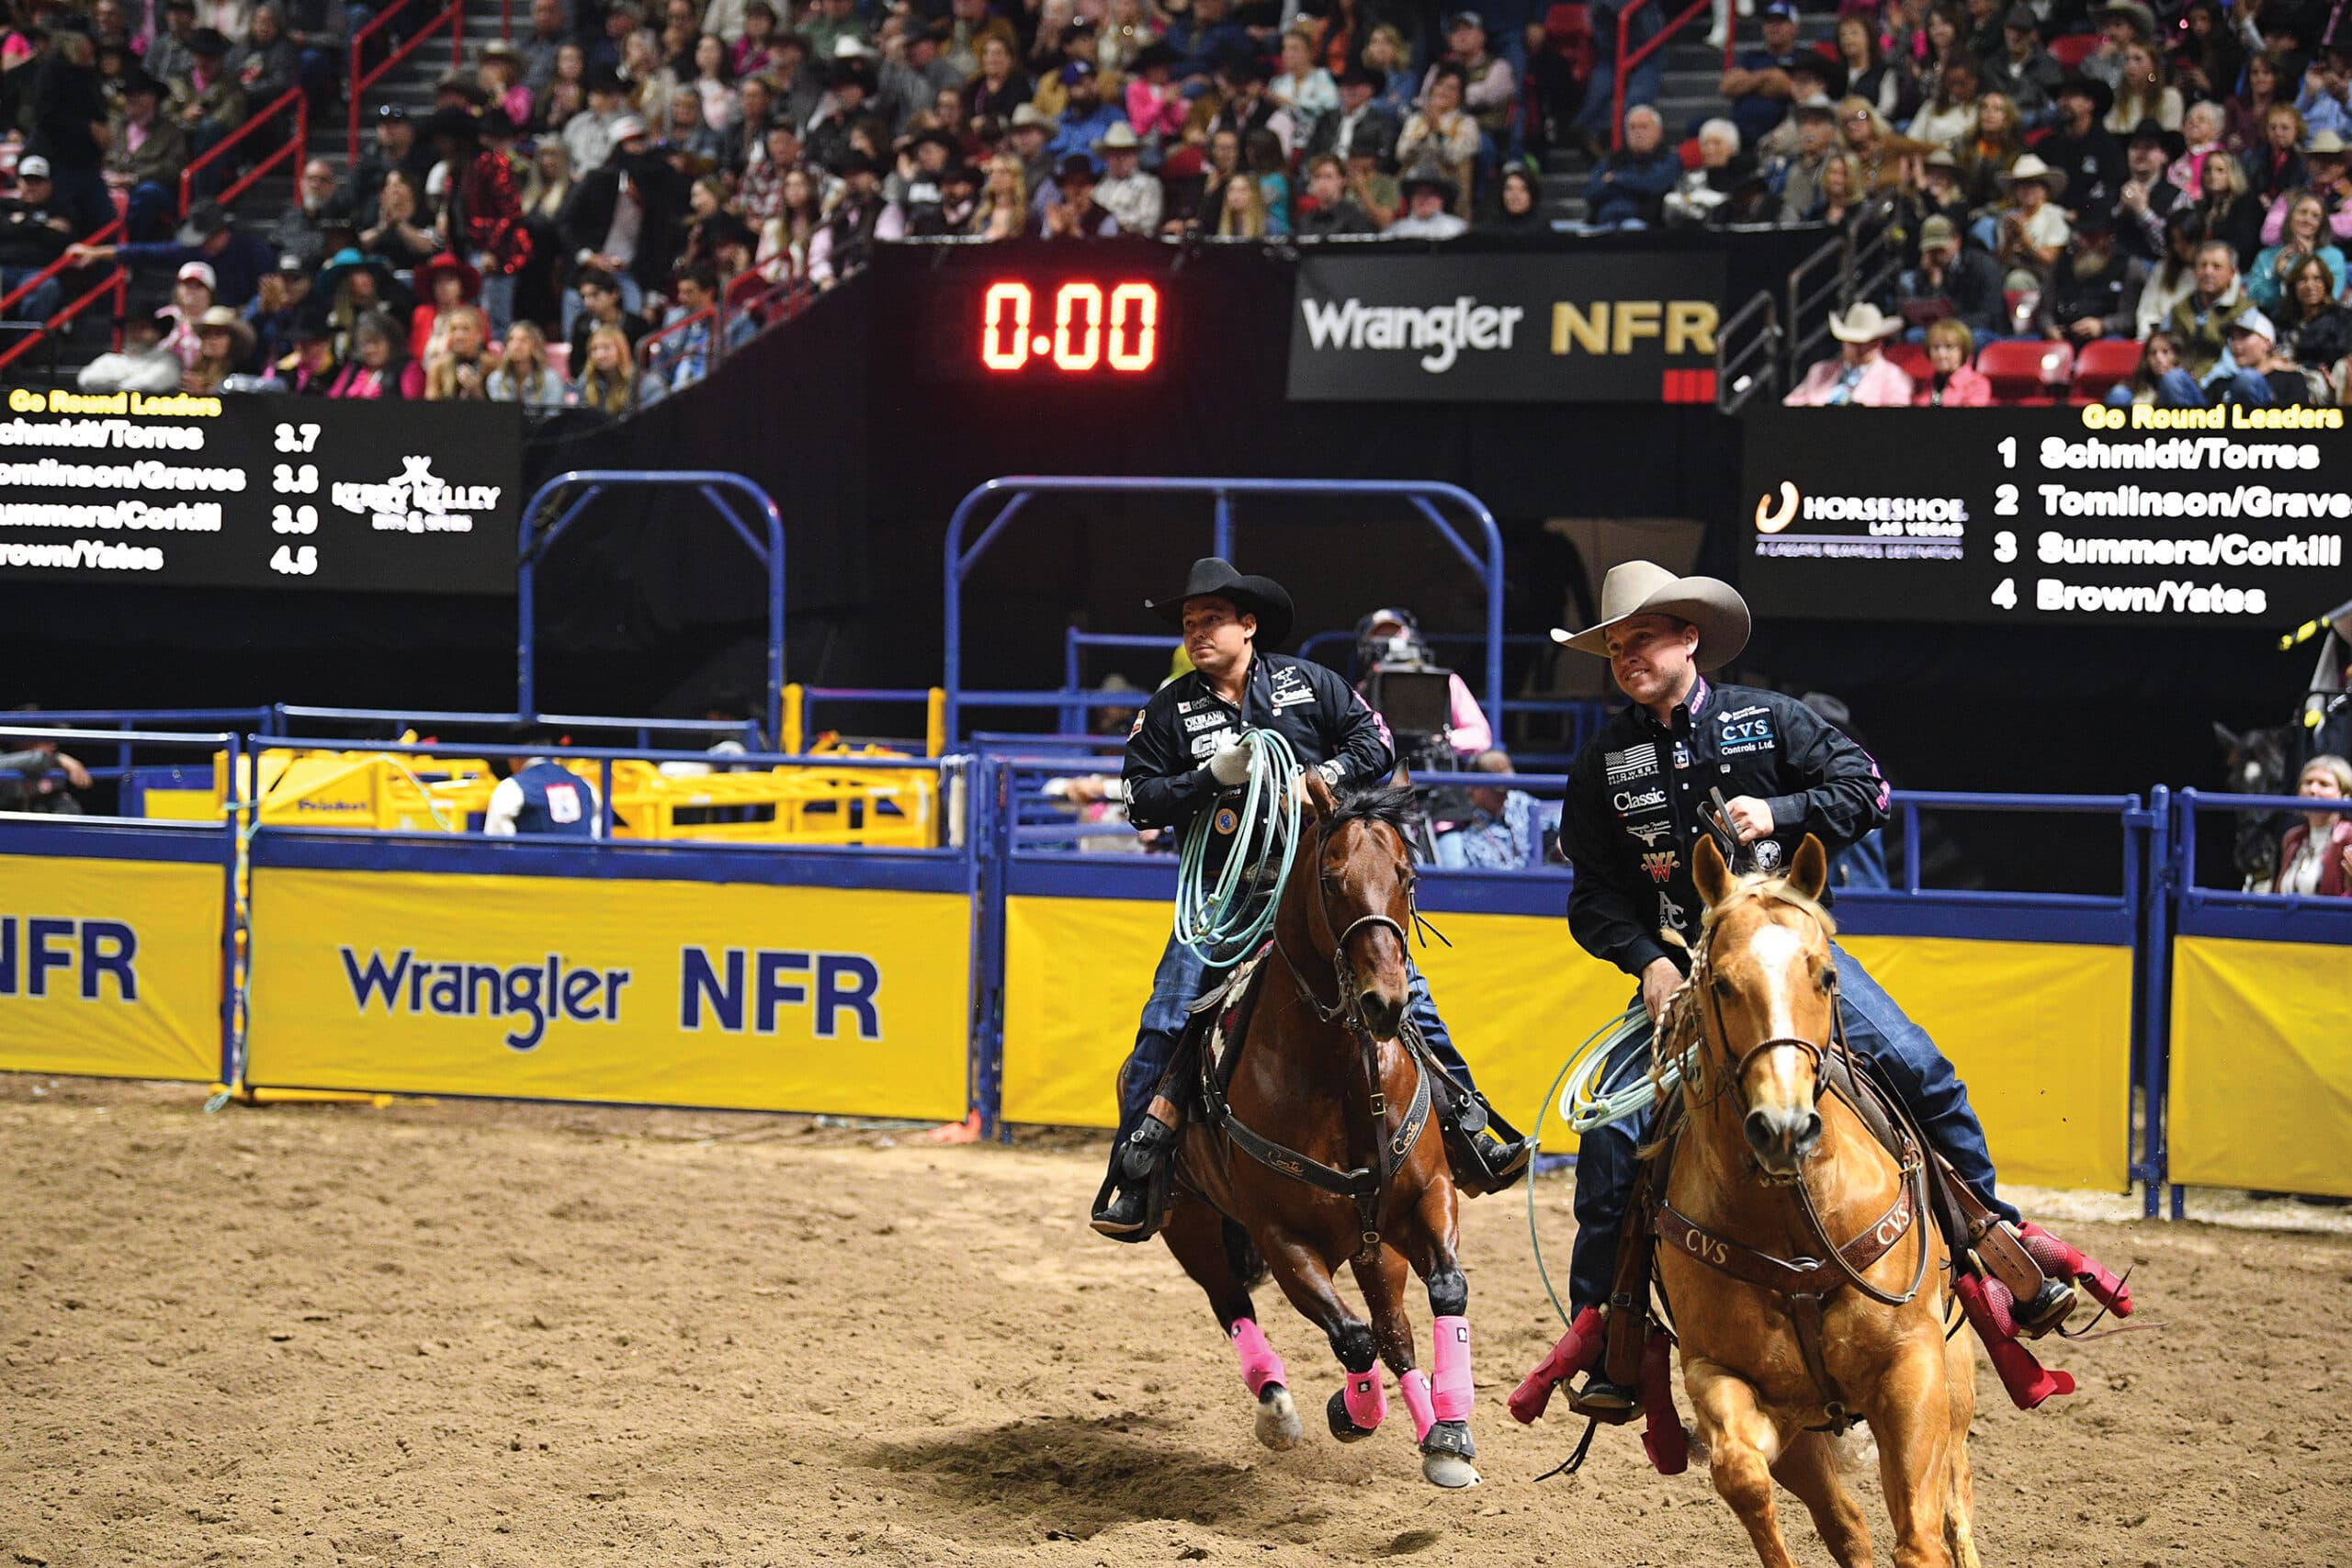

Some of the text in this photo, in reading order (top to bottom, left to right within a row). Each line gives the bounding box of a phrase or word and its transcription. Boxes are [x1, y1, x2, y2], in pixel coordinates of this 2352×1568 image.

[981, 282, 1159, 371] 0.00
[1303, 298, 1721, 371] Wrangler NFR
[9, 386, 221, 416] Go Round Leaders
[2083, 402, 2343, 429] Go Round Leaders
[0, 418, 321, 452] chmidt/Torres 3.7
[1998, 437, 2320, 469] 1 Schmidt/Torres
[0, 458, 246, 491] omlinson/Graves
[0, 501, 221, 531] ummers/Corkill
[1804, 497, 1969, 522] HORSESHOE
[1995, 484, 2352, 518] 2 Tomlinson/Grave
[0, 540, 164, 570] rown/Yates
[1994, 531, 2018, 562] 3
[2038, 532, 2341, 566] Summers/Corkill
[1992, 579, 2267, 614] 4 Brown/Yates
[1721, 719, 1770, 740] CVS
[1721, 742, 1757, 756] Controls
[1613, 786, 1668, 811] Classic
[0, 916, 139, 1003] FR
[338, 945, 882, 1054] Wrangler NFR
[1876, 1201, 1911, 1246] CVS
[1685, 1228, 1729, 1265] CVS
